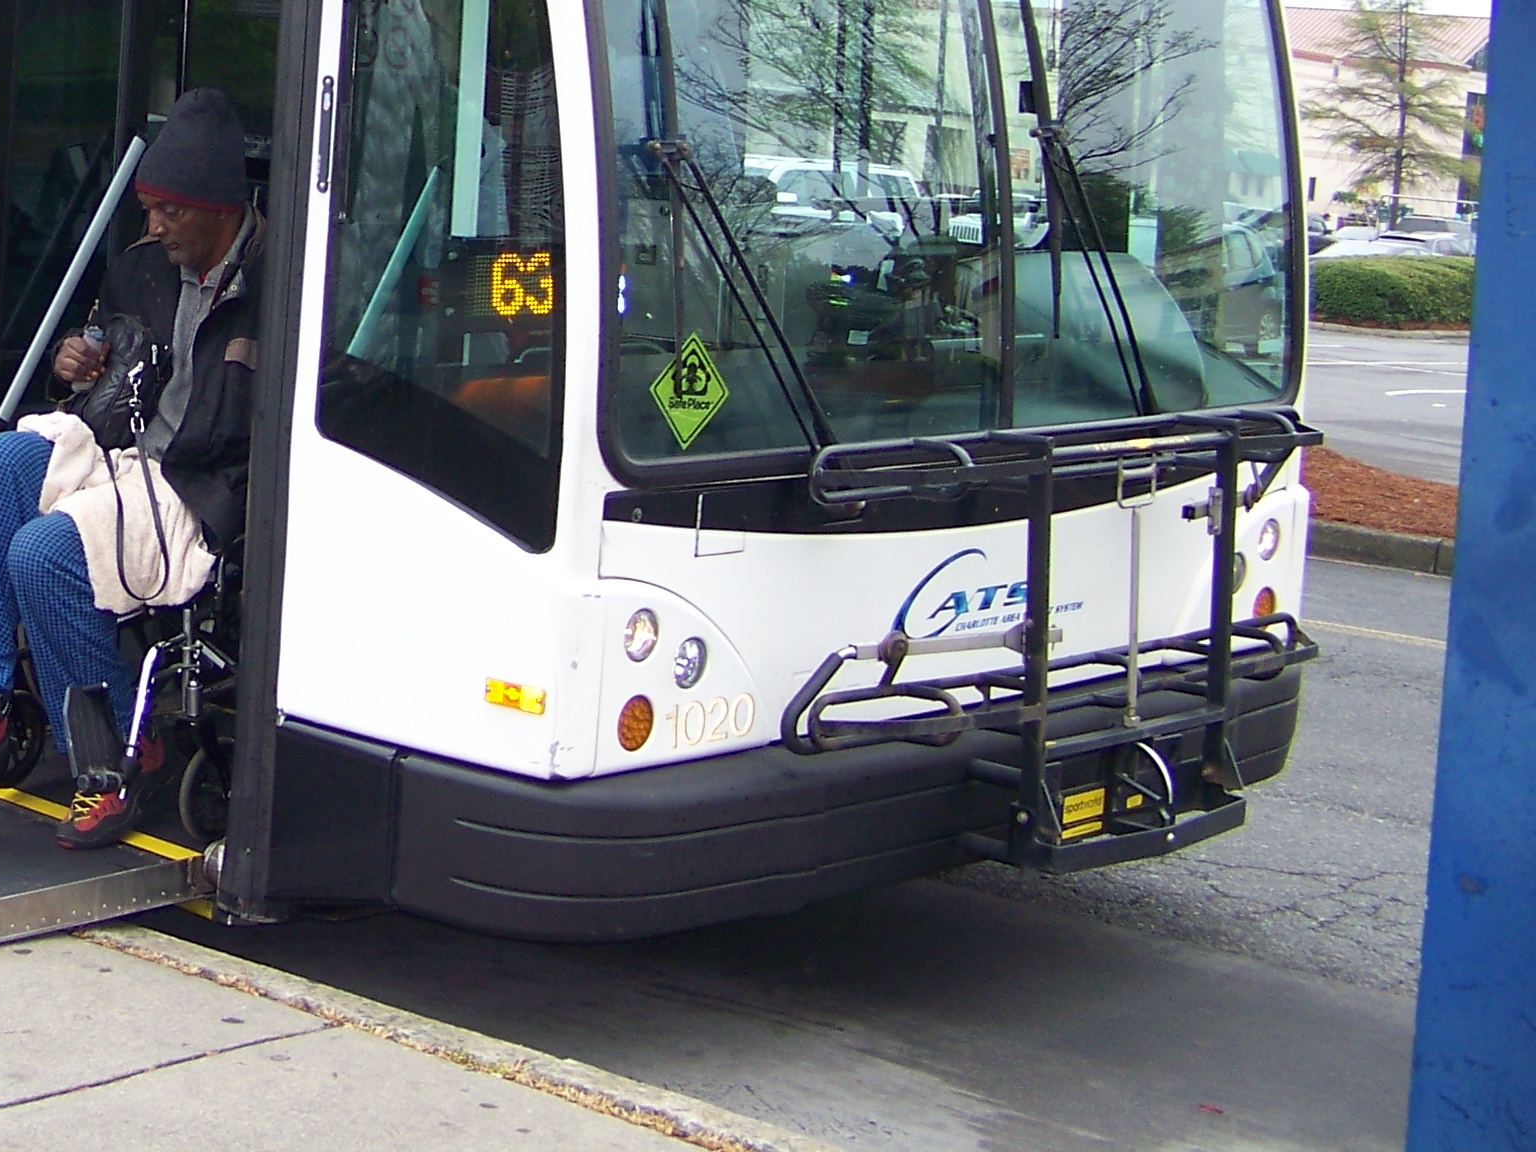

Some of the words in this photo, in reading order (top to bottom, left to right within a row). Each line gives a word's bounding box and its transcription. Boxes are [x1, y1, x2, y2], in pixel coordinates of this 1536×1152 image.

[954, 615, 999, 632] CHARLOTTE
[1001, 612, 1021, 624] AREA
[666, 691, 756, 749] 1020
